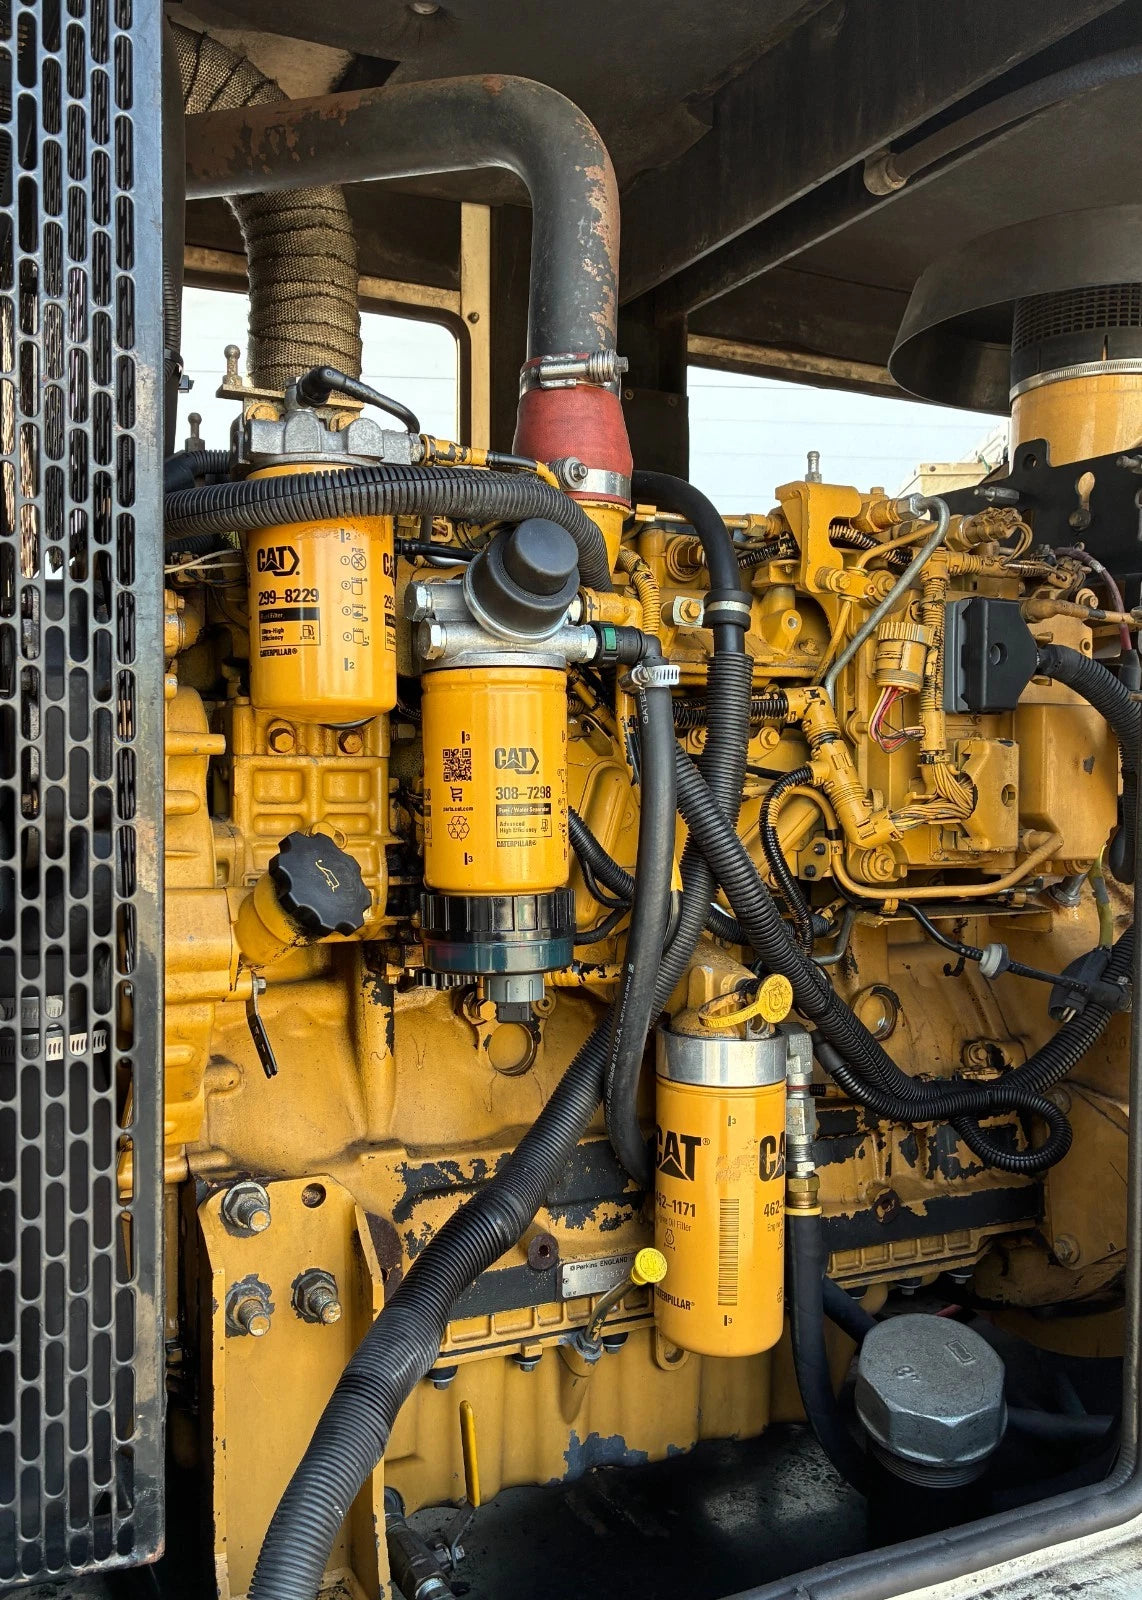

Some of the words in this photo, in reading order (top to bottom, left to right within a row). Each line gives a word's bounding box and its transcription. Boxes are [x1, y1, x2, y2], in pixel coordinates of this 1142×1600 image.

[257, 546, 288, 573] CAT
[258, 588, 319, 606] 299-8229
[495, 748, 530, 770] CAT
[495, 785, 551, 800] 308-7298
[614, 1028, 623, 1053] U.S.A.
[613, 1053, 618, 1062] in
[608, 1062, 616, 1083] Made
[576, 1263, 598, 1271] Perkins
[600, 1256, 628, 1267] ENGLAND
